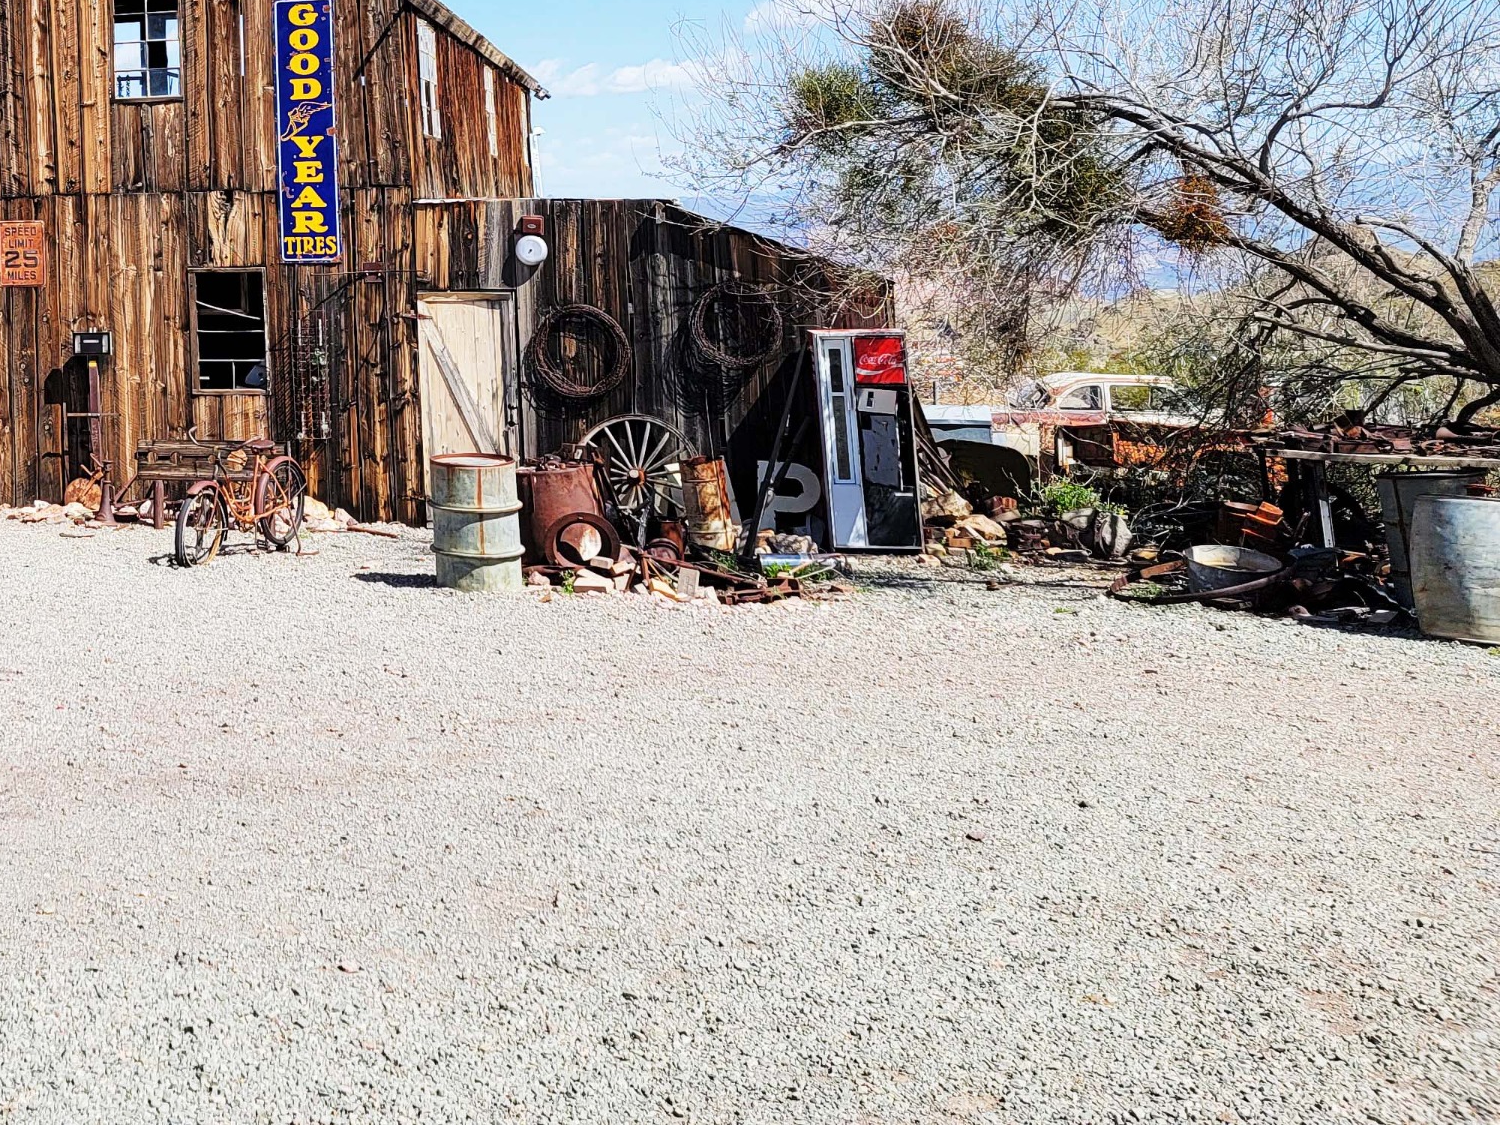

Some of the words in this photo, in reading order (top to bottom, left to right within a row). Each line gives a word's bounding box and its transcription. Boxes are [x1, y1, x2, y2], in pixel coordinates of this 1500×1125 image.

[4, 226, 37, 237] SPEED
[8, 238, 34, 249] LIMIT
[283, 235, 338, 257] TIRES
[4, 250, 39, 268] 25
[7, 270, 37, 281] MILES
